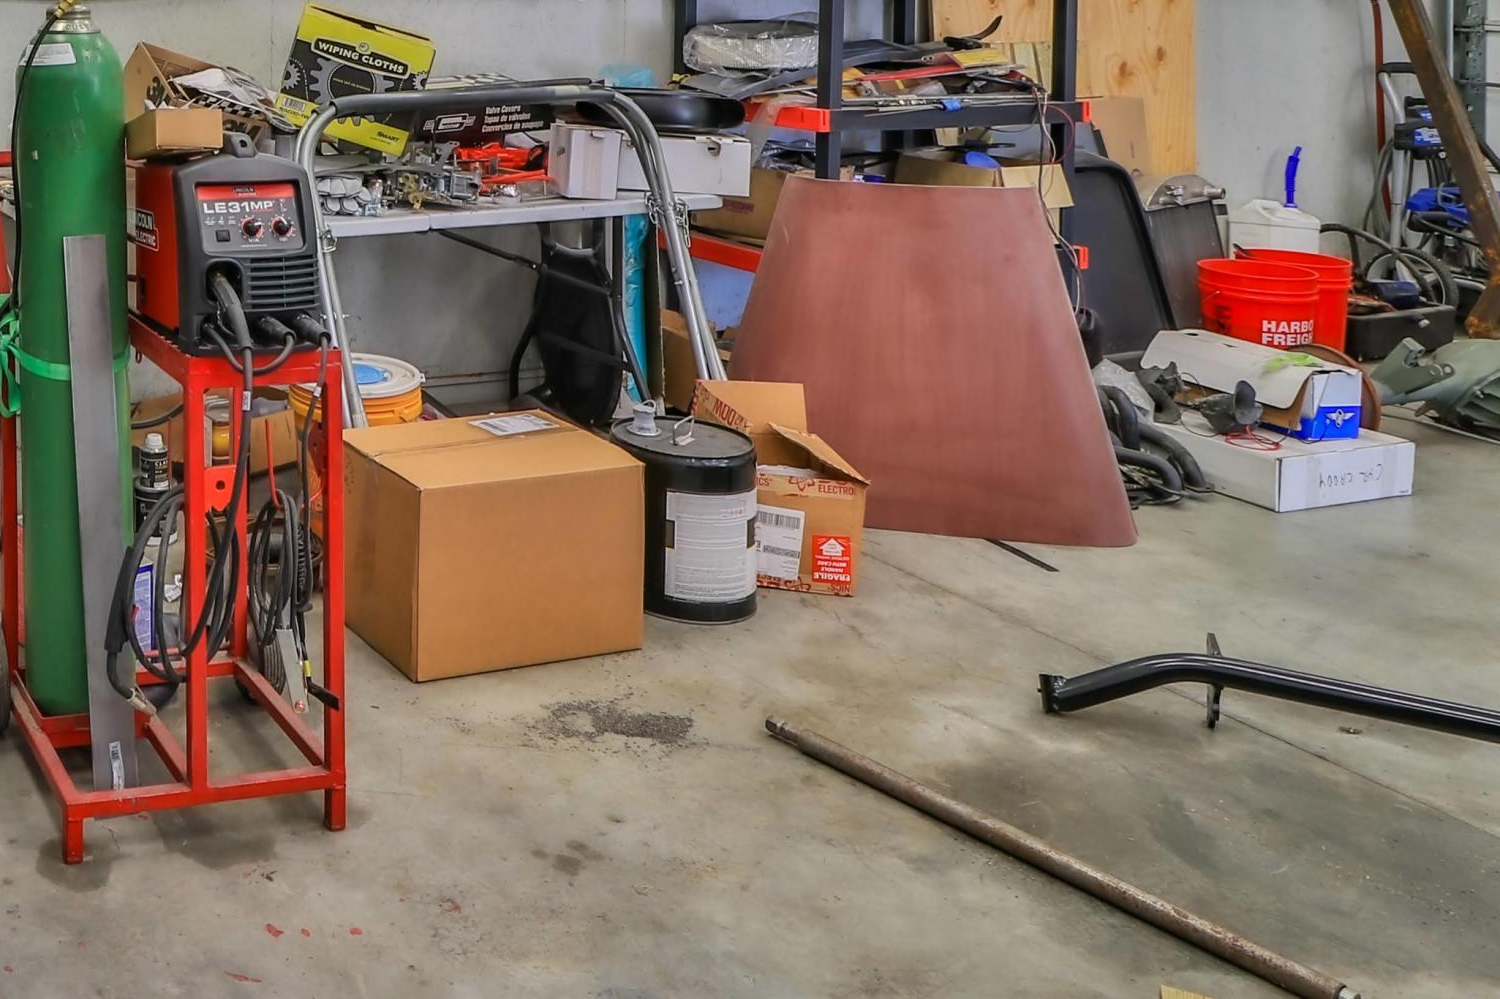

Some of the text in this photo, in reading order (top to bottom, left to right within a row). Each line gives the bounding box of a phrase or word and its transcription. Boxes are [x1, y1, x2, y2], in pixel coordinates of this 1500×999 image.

[318, 41, 405, 73] WIPING CLOTHS
[501, 105, 521, 113] Covers
[203, 200, 274, 214] LE31MP
[818, 484, 854, 496] ELECTRO
[813, 571, 851, 582] FRAGILE
